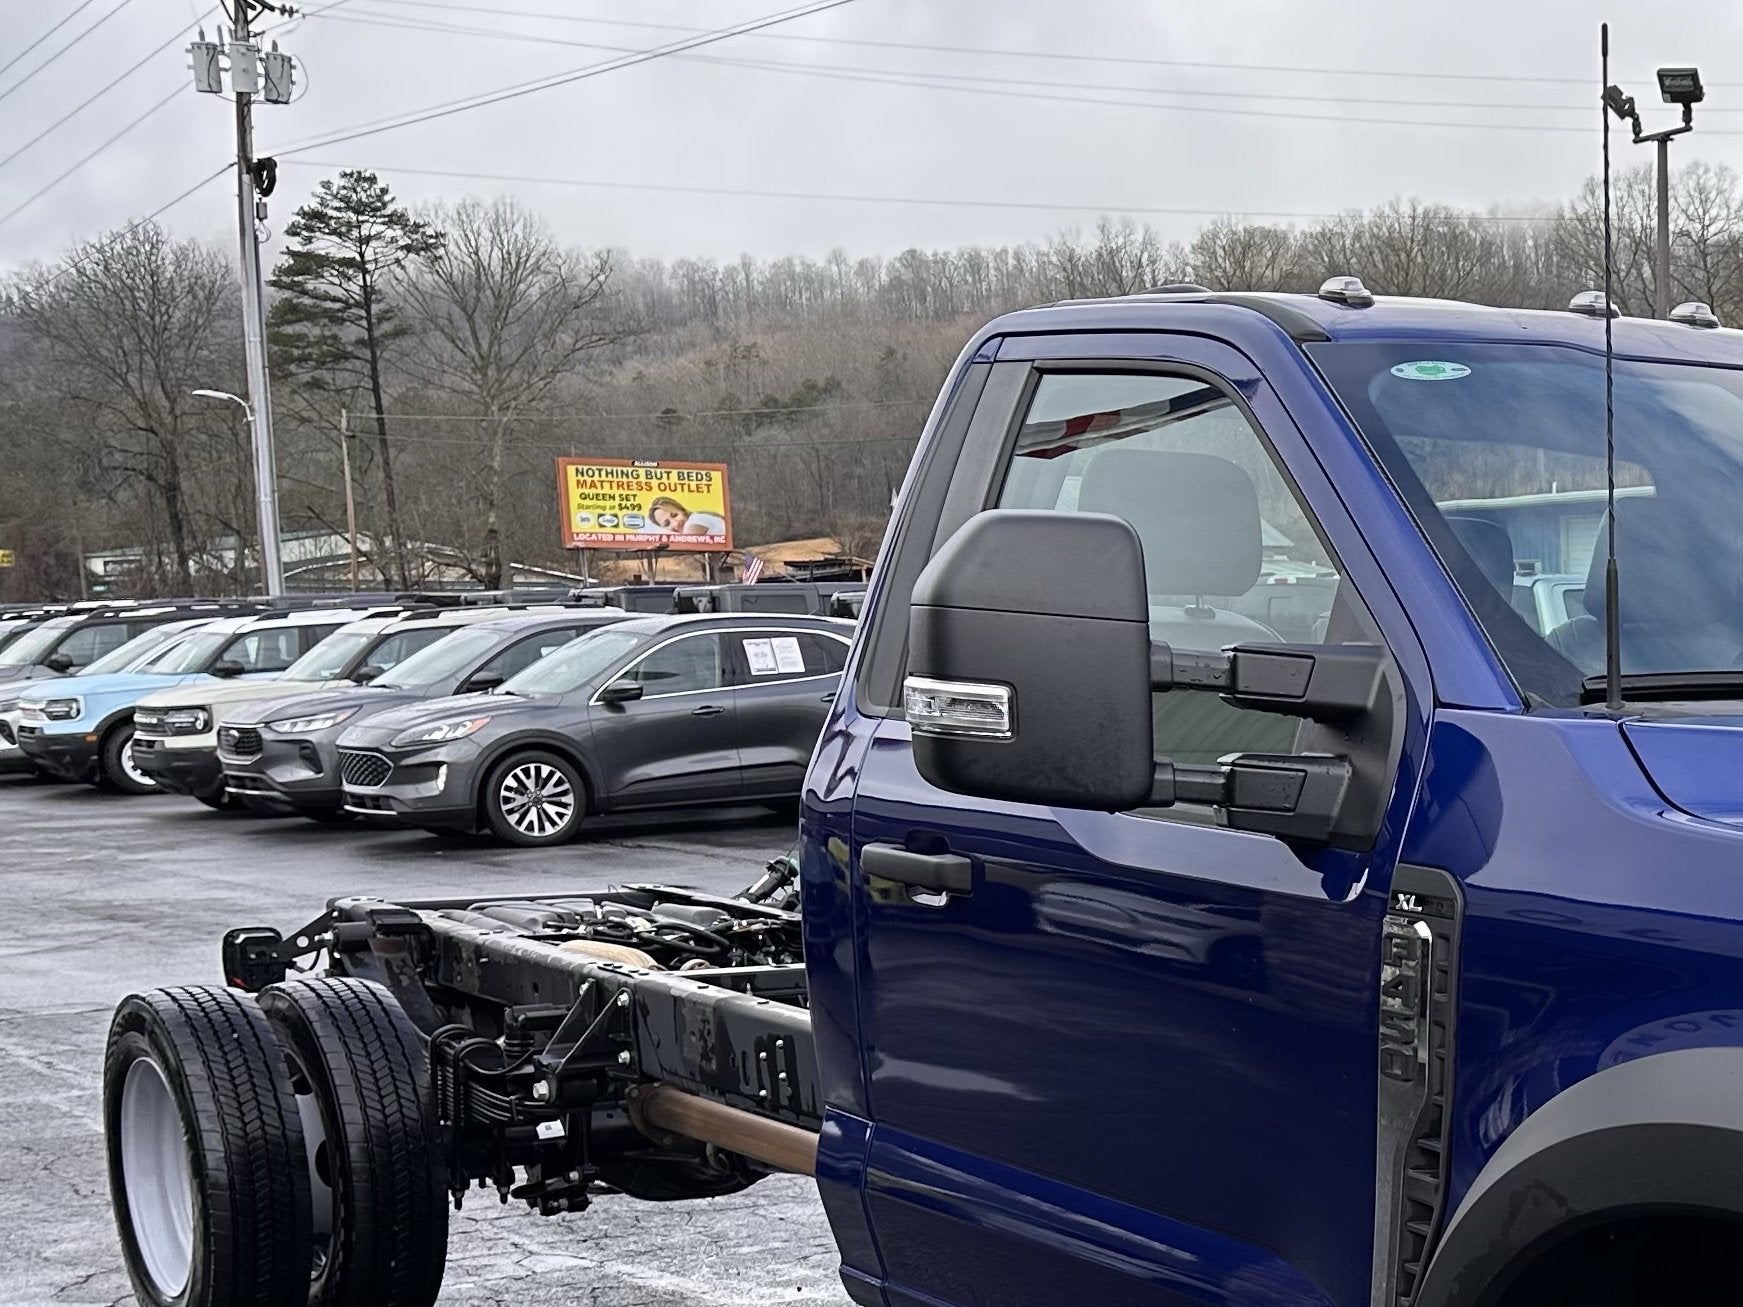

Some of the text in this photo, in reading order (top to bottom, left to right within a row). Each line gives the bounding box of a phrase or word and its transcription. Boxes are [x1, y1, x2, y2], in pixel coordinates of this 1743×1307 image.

[575, 467, 713, 482] NOTHING BUT BEDS
[576, 479, 713, 493] MATTRESS OUTLET
[579, 492, 637, 502] QUEEN SET
[577, 503, 607, 511] Starting
[617, 503, 643, 511] $499
[573, 533, 614, 542] LOCATED
[615, 534, 624, 542] IN
[626, 534, 660, 543] MURPHY
[1396, 893, 1423, 912] XL
